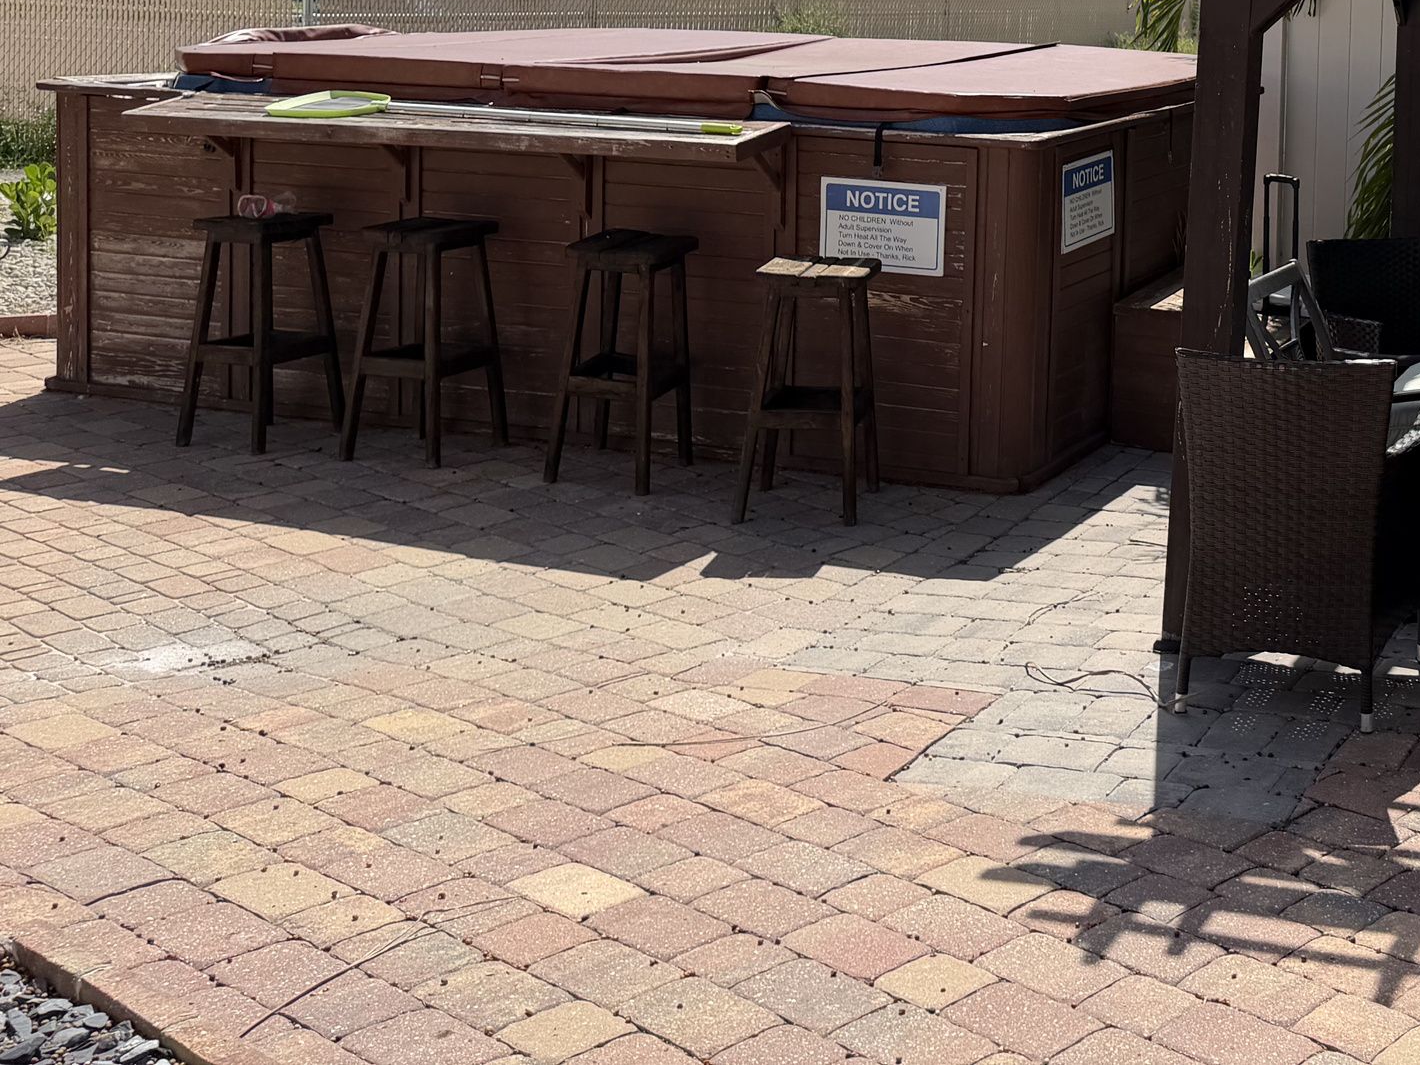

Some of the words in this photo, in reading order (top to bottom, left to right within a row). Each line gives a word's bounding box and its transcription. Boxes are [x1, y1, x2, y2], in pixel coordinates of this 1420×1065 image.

[1072, 164, 1104, 190] NOTICE
[846, 190, 920, 212] NOTICE
[850, 215, 886, 224] CHILDREN
[890, 218, 914, 227] Without
[856, 224, 892, 234] Supervision
